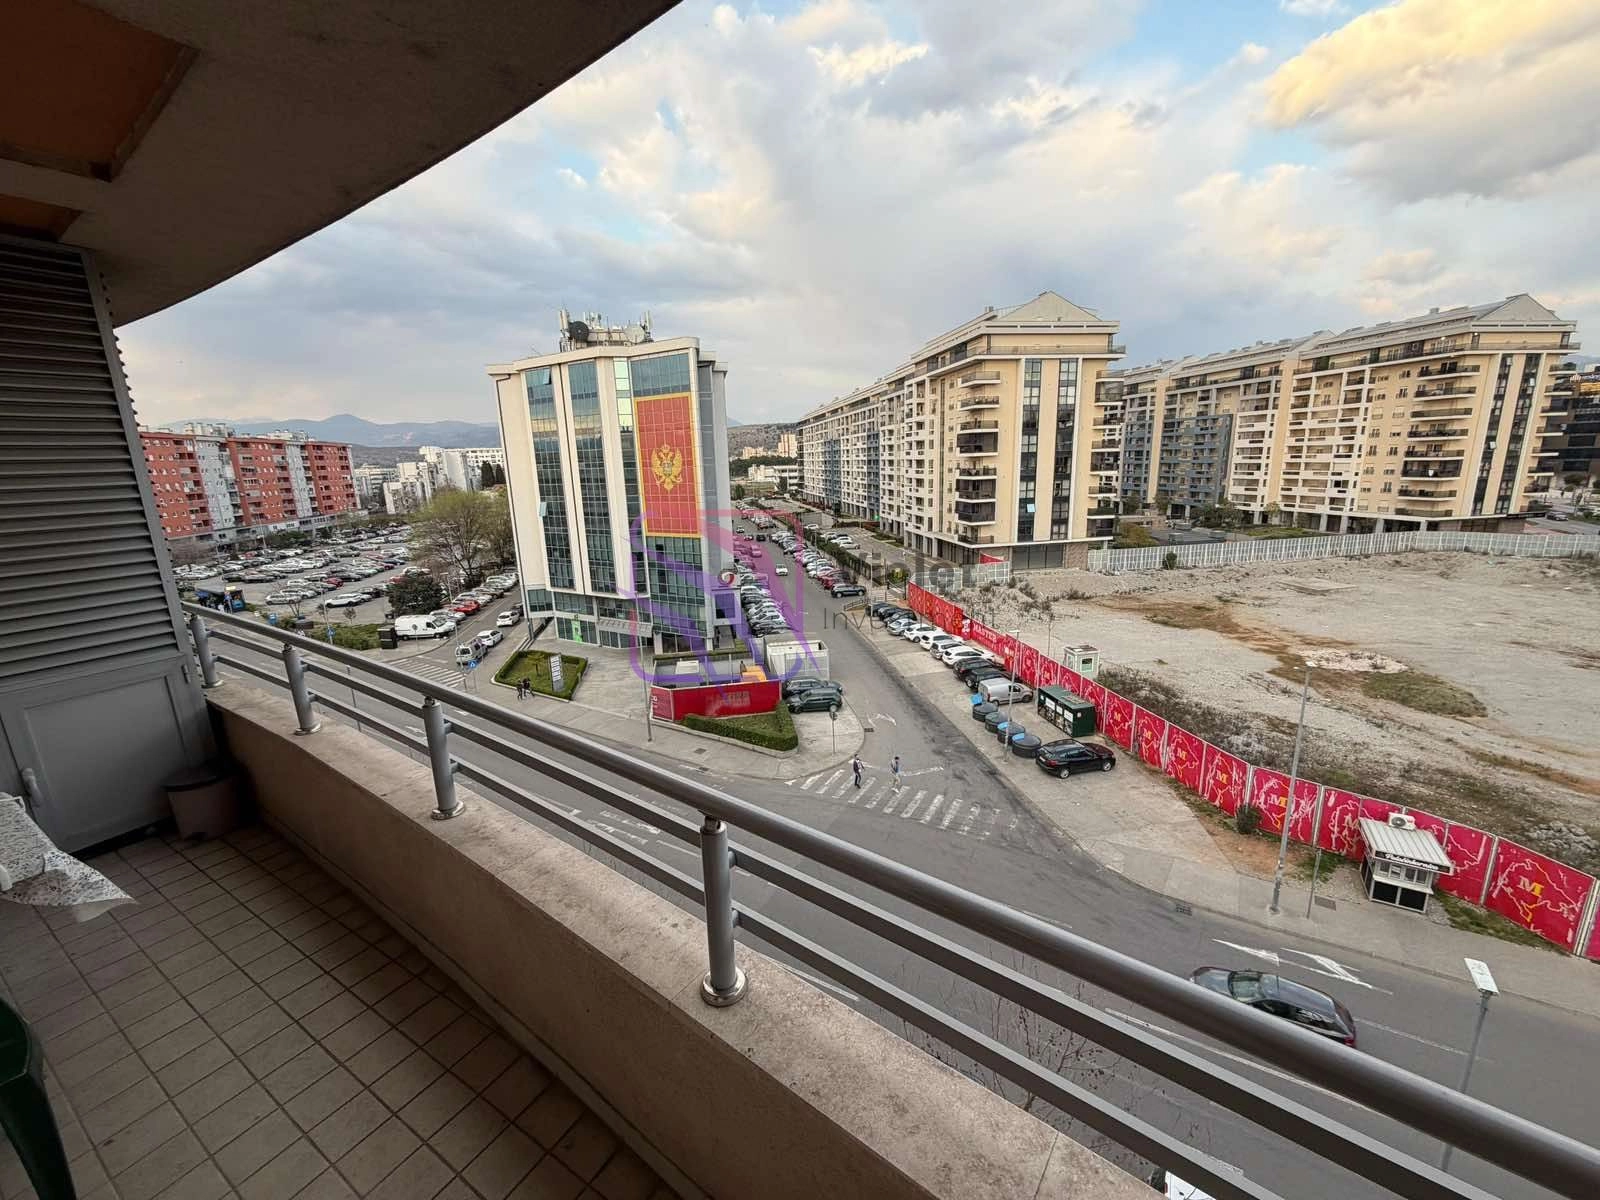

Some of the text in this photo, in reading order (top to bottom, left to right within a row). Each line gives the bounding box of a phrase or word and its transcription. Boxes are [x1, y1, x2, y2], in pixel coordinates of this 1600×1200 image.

[1176, 746, 1188, 761] M
[1215, 768, 1229, 785] M
[1267, 793, 1289, 809] M
[1516, 875, 1545, 898] M
